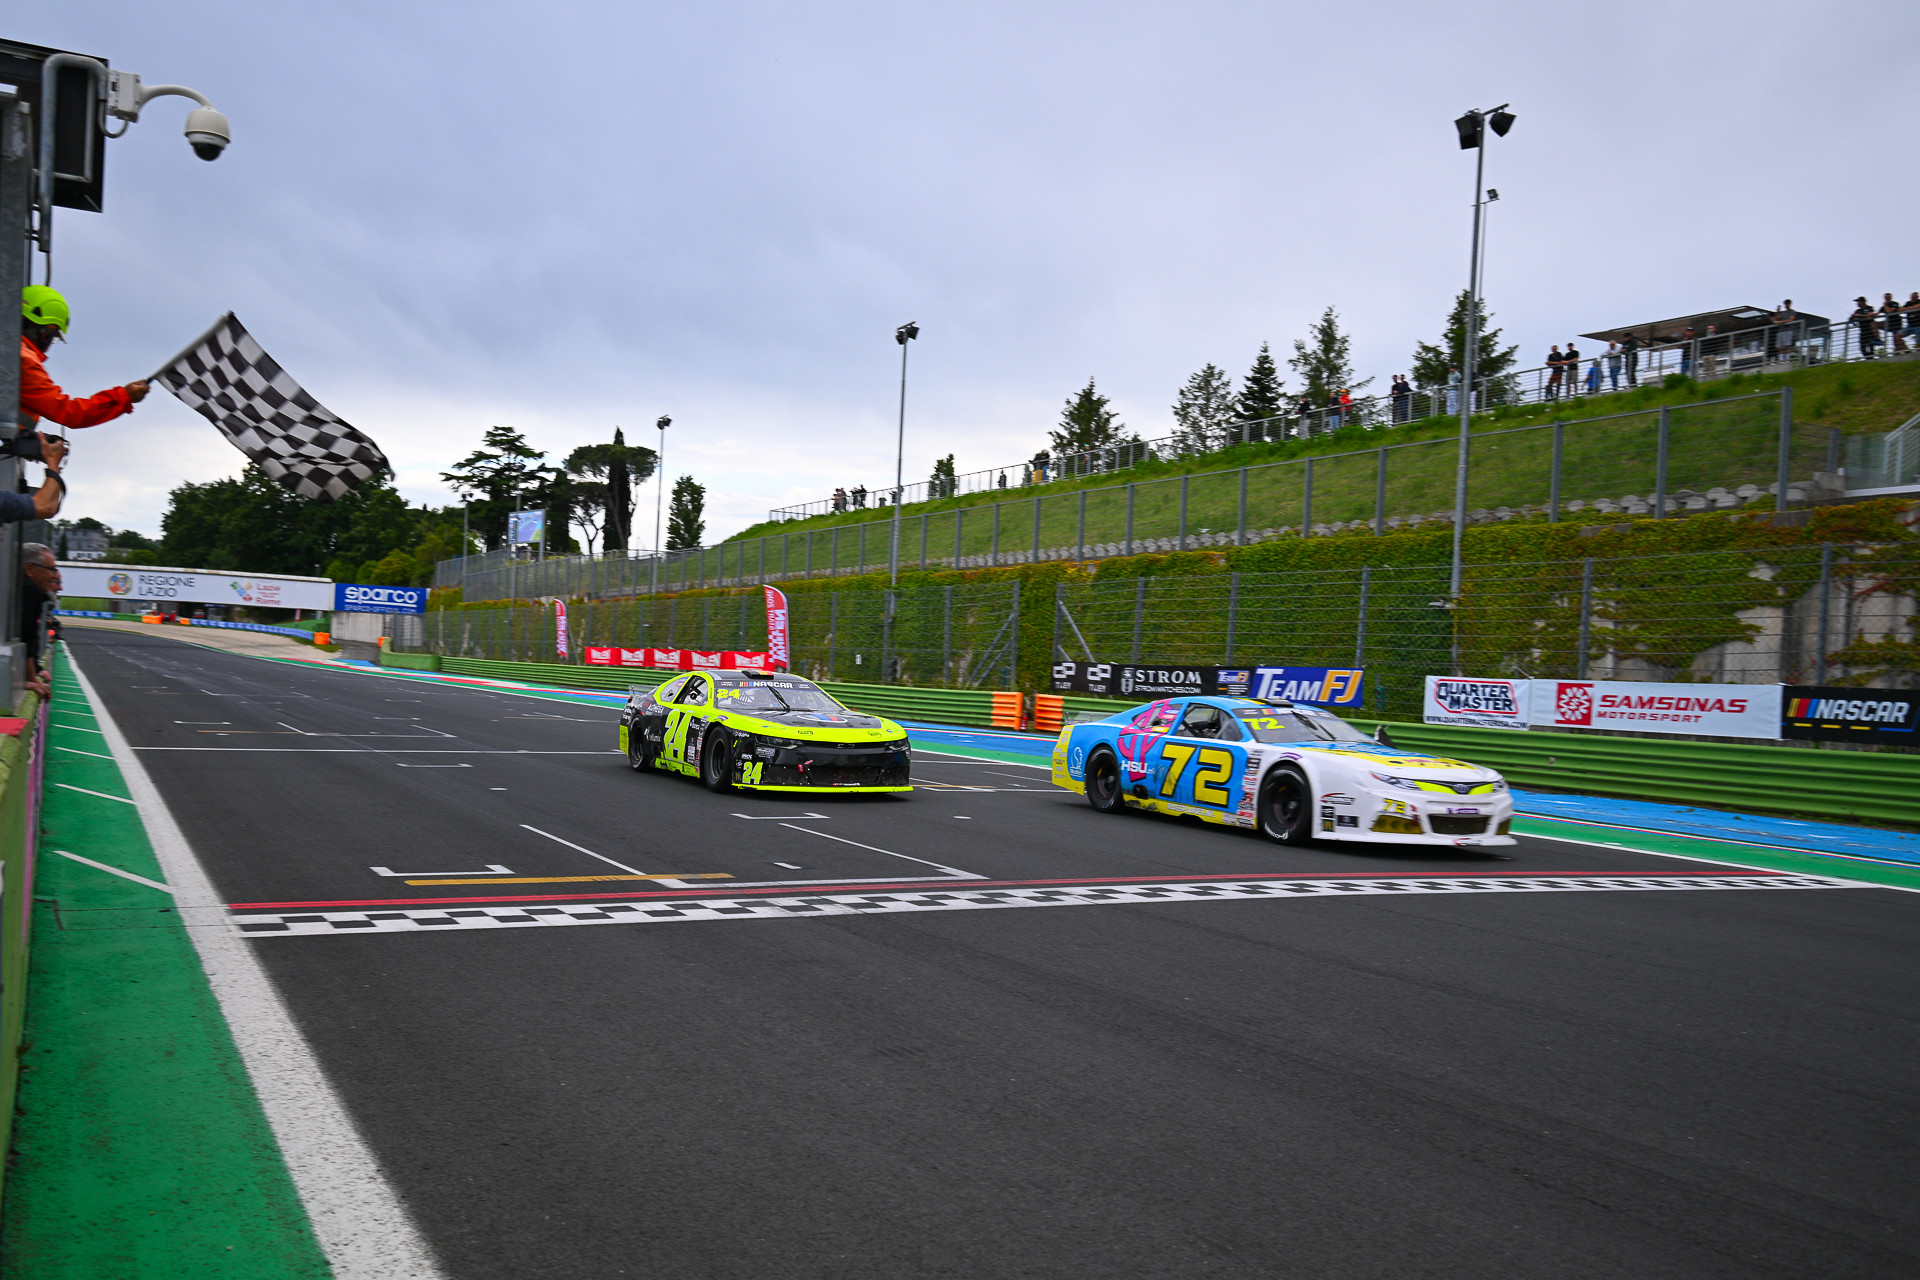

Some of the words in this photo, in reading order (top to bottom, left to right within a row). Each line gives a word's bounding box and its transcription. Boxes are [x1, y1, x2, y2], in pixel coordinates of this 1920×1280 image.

[138, 574, 196, 588] REGIONE
[138, 586, 178, 598] LAZIO
[344, 586, 419, 604] sparco
[752, 681, 794, 689] NASCAR
[1135, 668, 1203, 685] STROM
[716, 688, 742, 699] 24
[1437, 682, 1509, 701] QUARTER
[1448, 695, 1514, 712] MASTER
[1599, 694, 1749, 714] SAMSONAS
[1814, 698, 1911, 723] NASCAR
[1241, 717, 1286, 730] 72
[1595, 710, 1703, 723] MOTORSPORT
[664, 708, 694, 763] 24
[742, 761, 764, 784] 24
[1159, 740, 1234, 810] 72
[1383, 798, 1406, 814] 72
